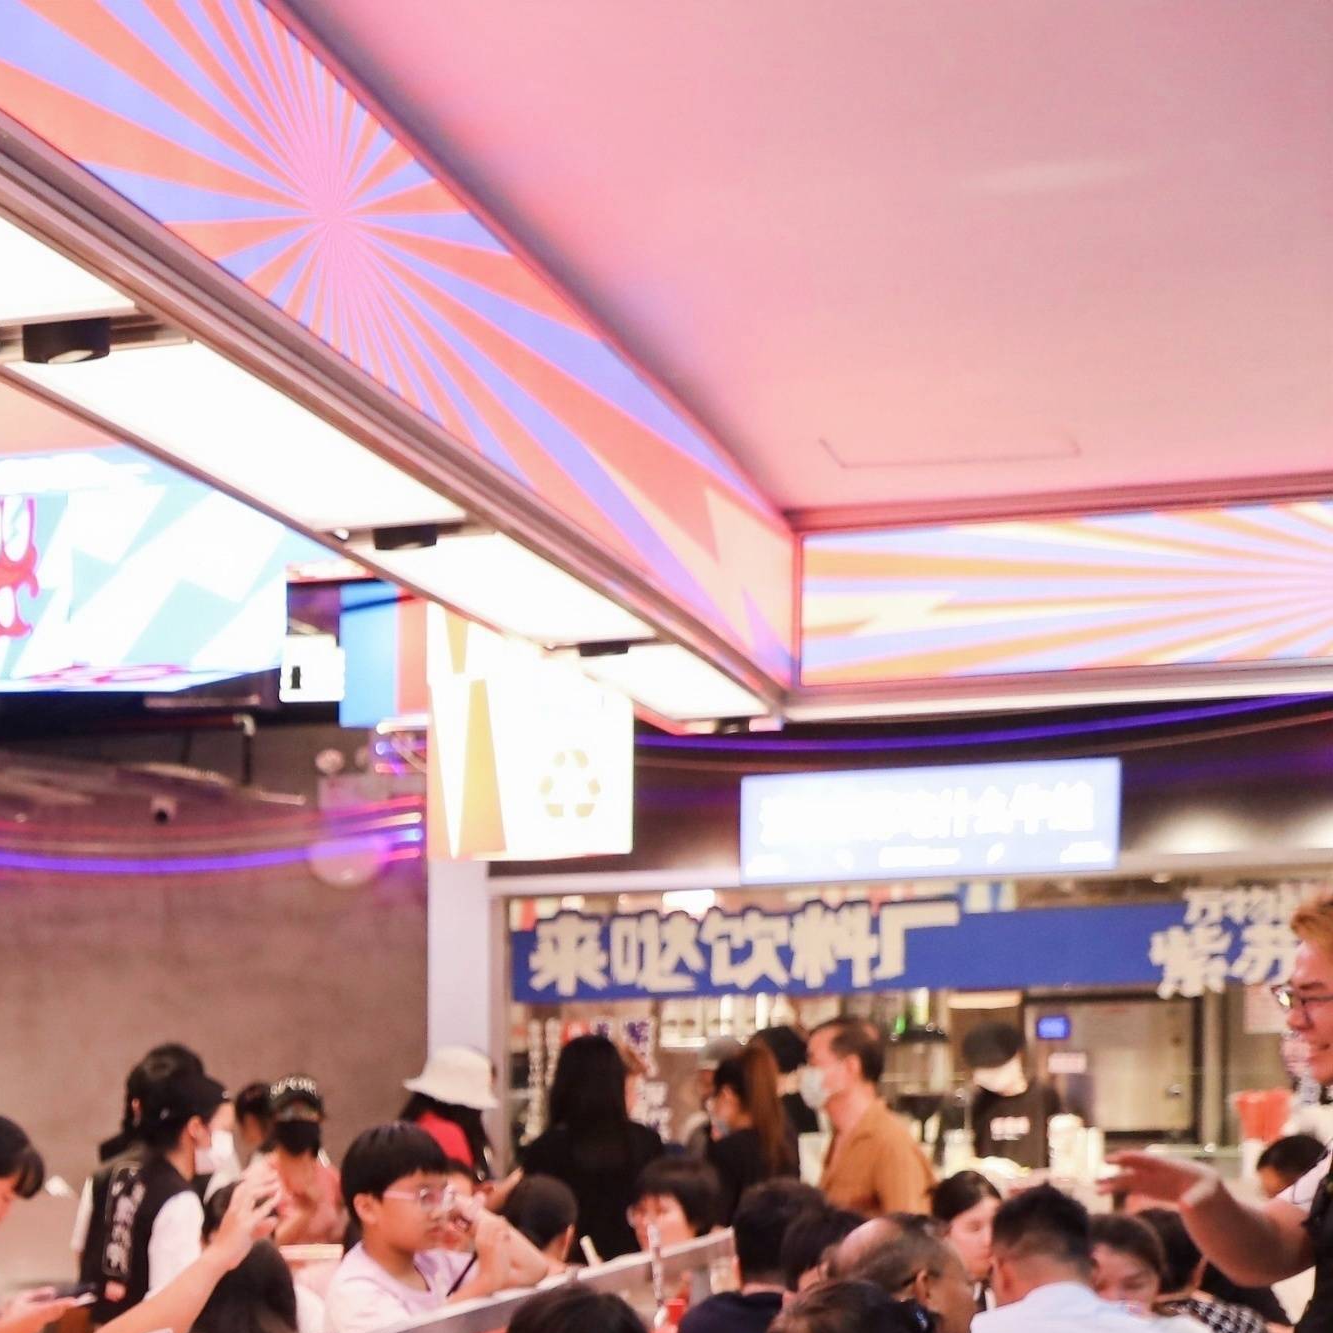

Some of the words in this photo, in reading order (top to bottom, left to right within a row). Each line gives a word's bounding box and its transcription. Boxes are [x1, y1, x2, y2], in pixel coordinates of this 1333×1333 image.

[528, 899, 961, 997] 来哒饮料厂
